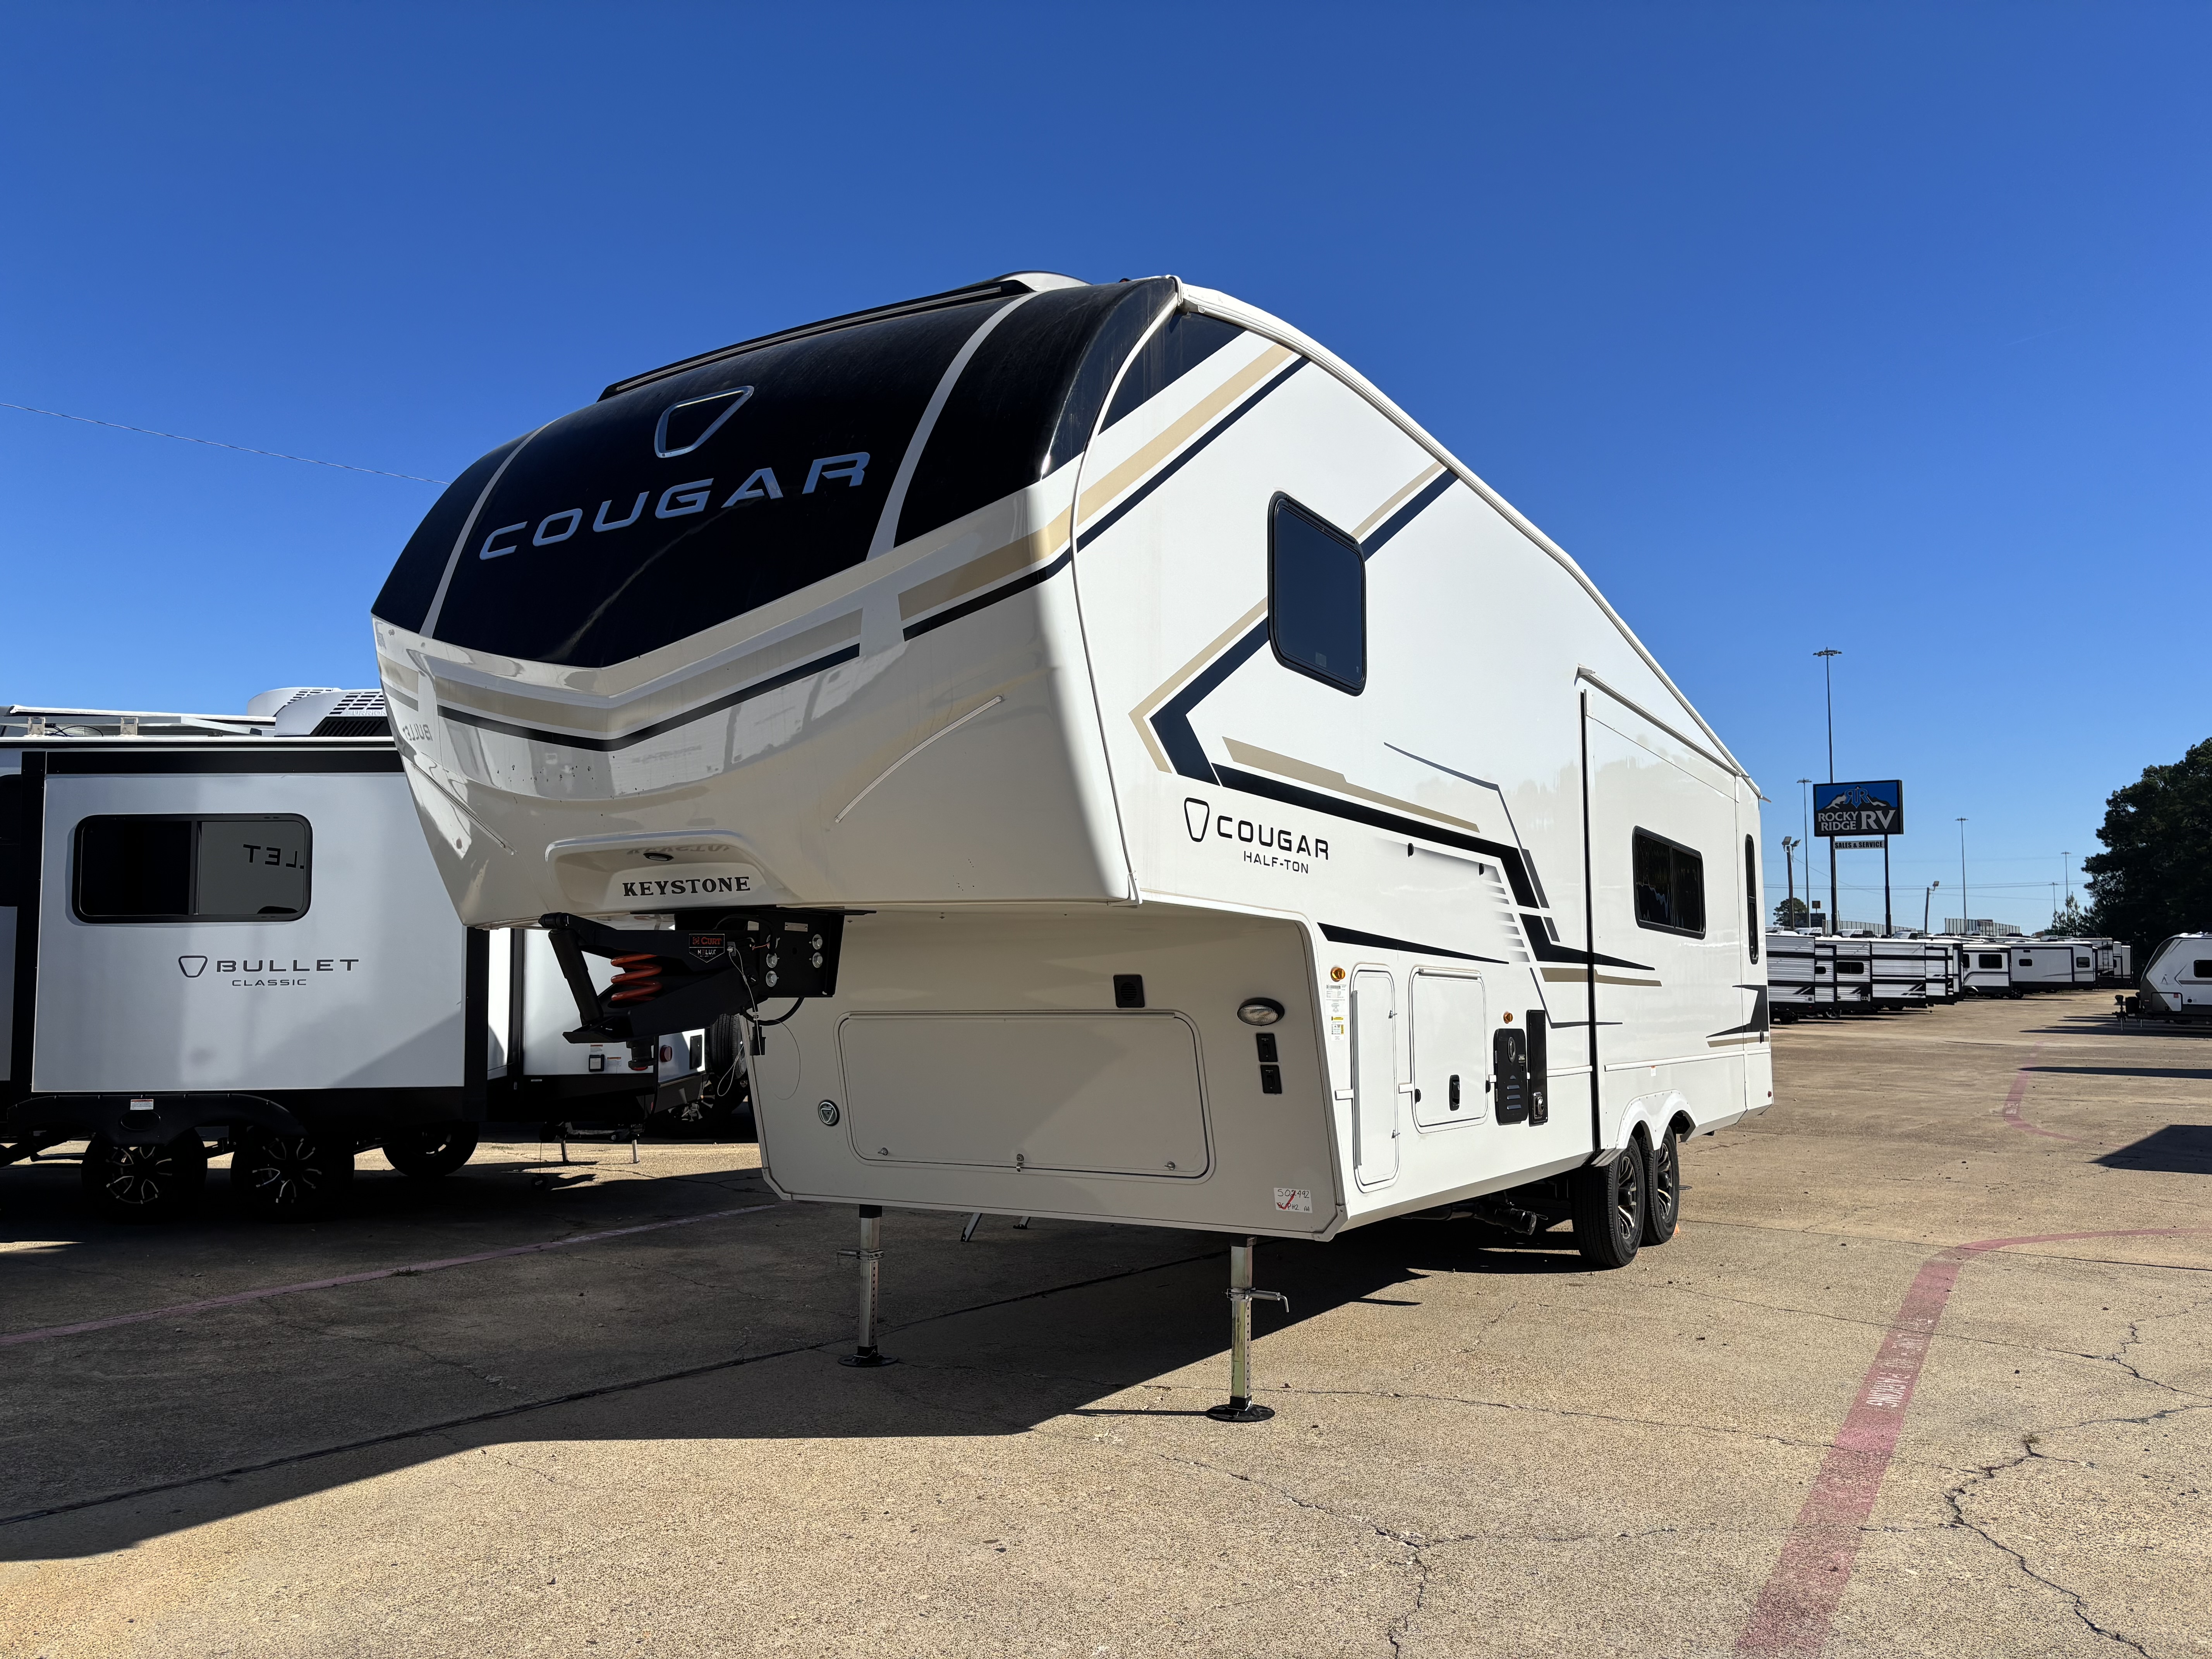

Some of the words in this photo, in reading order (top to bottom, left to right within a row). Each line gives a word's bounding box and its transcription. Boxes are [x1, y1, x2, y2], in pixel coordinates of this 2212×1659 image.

[479, 452, 870, 560] COUGAR
[1818, 811, 1858, 822] ROCKY
[1821, 821, 1856, 831] RIDGE
[1860, 810, 1896, 830] RV
[1217, 815, 1329, 860] COUGAR
[1244, 850, 1309, 874] HALF-TON
[623, 876, 751, 896] KEYSTONE
[701, 937, 722, 945] CURT
[216, 959, 359, 972] BULLET
[1866, 1372, 1911, 1407] PARKING
